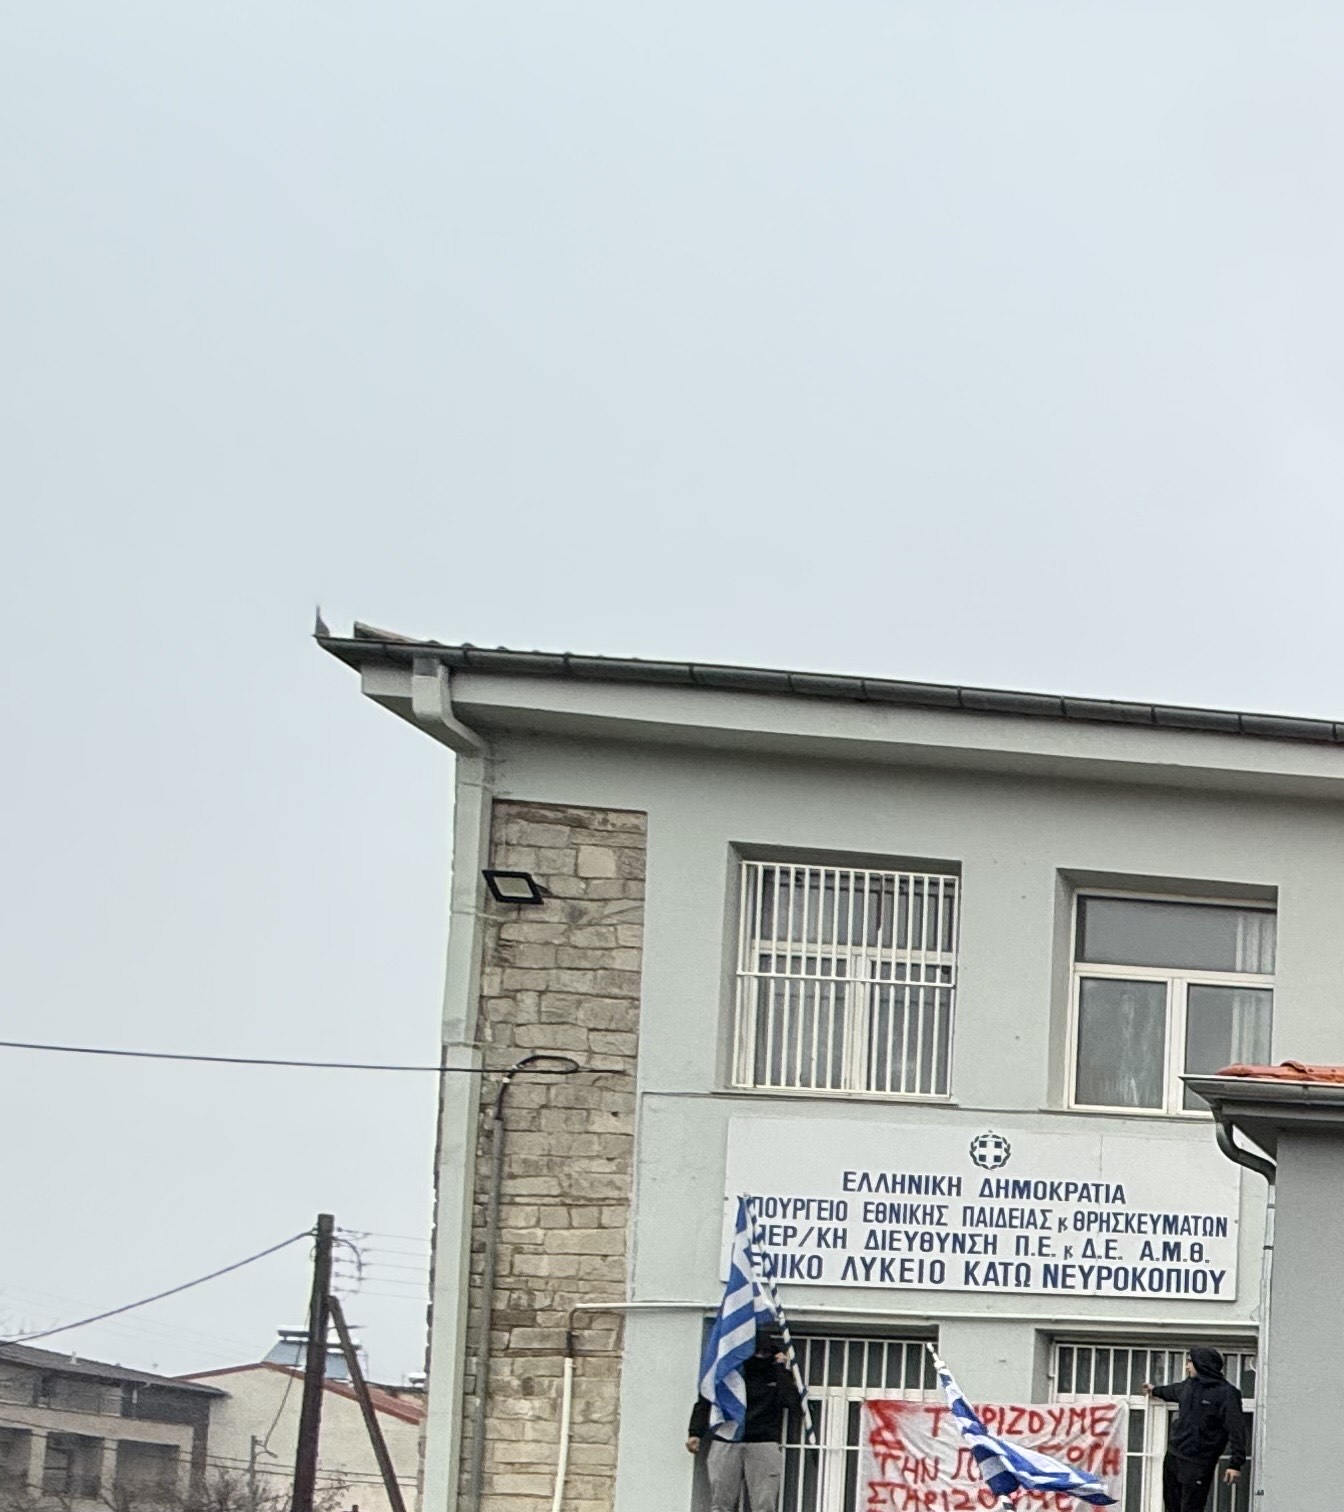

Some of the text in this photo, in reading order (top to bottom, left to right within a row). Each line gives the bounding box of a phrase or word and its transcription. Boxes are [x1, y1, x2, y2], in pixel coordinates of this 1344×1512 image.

[842, 1171, 1127, 1204] ΕΛΛΗΝΙΚΗ ΔΗΜΟΚΡΑΤΙΑ
[746, 1196, 848, 1222] ΠΟΥΡΓΕΙΟ
[863, 1201, 949, 1227] ΕΘΝΙΚΗΣ
[962, 1205, 1053, 1231] ΠΑΙΔΕΙΑΣ
[1073, 1210, 1228, 1237] ΘΡΗΣΚΕΥΜΑΤΩΝ
[864, 1229, 998, 1255] ΔΙΕΥΘΥΝΣΗ
[1015, 1235, 1056, 1258] Π.Ε.
[1081, 1238, 1123, 1261] Δ.Ε.
[1139, 1241, 1210, 1263] Α.Μ.Θ.
[841, 1256, 946, 1285] ΛΥΚΕΙΟ
[964, 1260, 1032, 1288] ΚΑΤΩ
[1042, 1263, 1226, 1295] ΝΕΥΡΟΚΟΠΙΟΥ
[873, 1451, 940, 1484] ΤΗΝ
